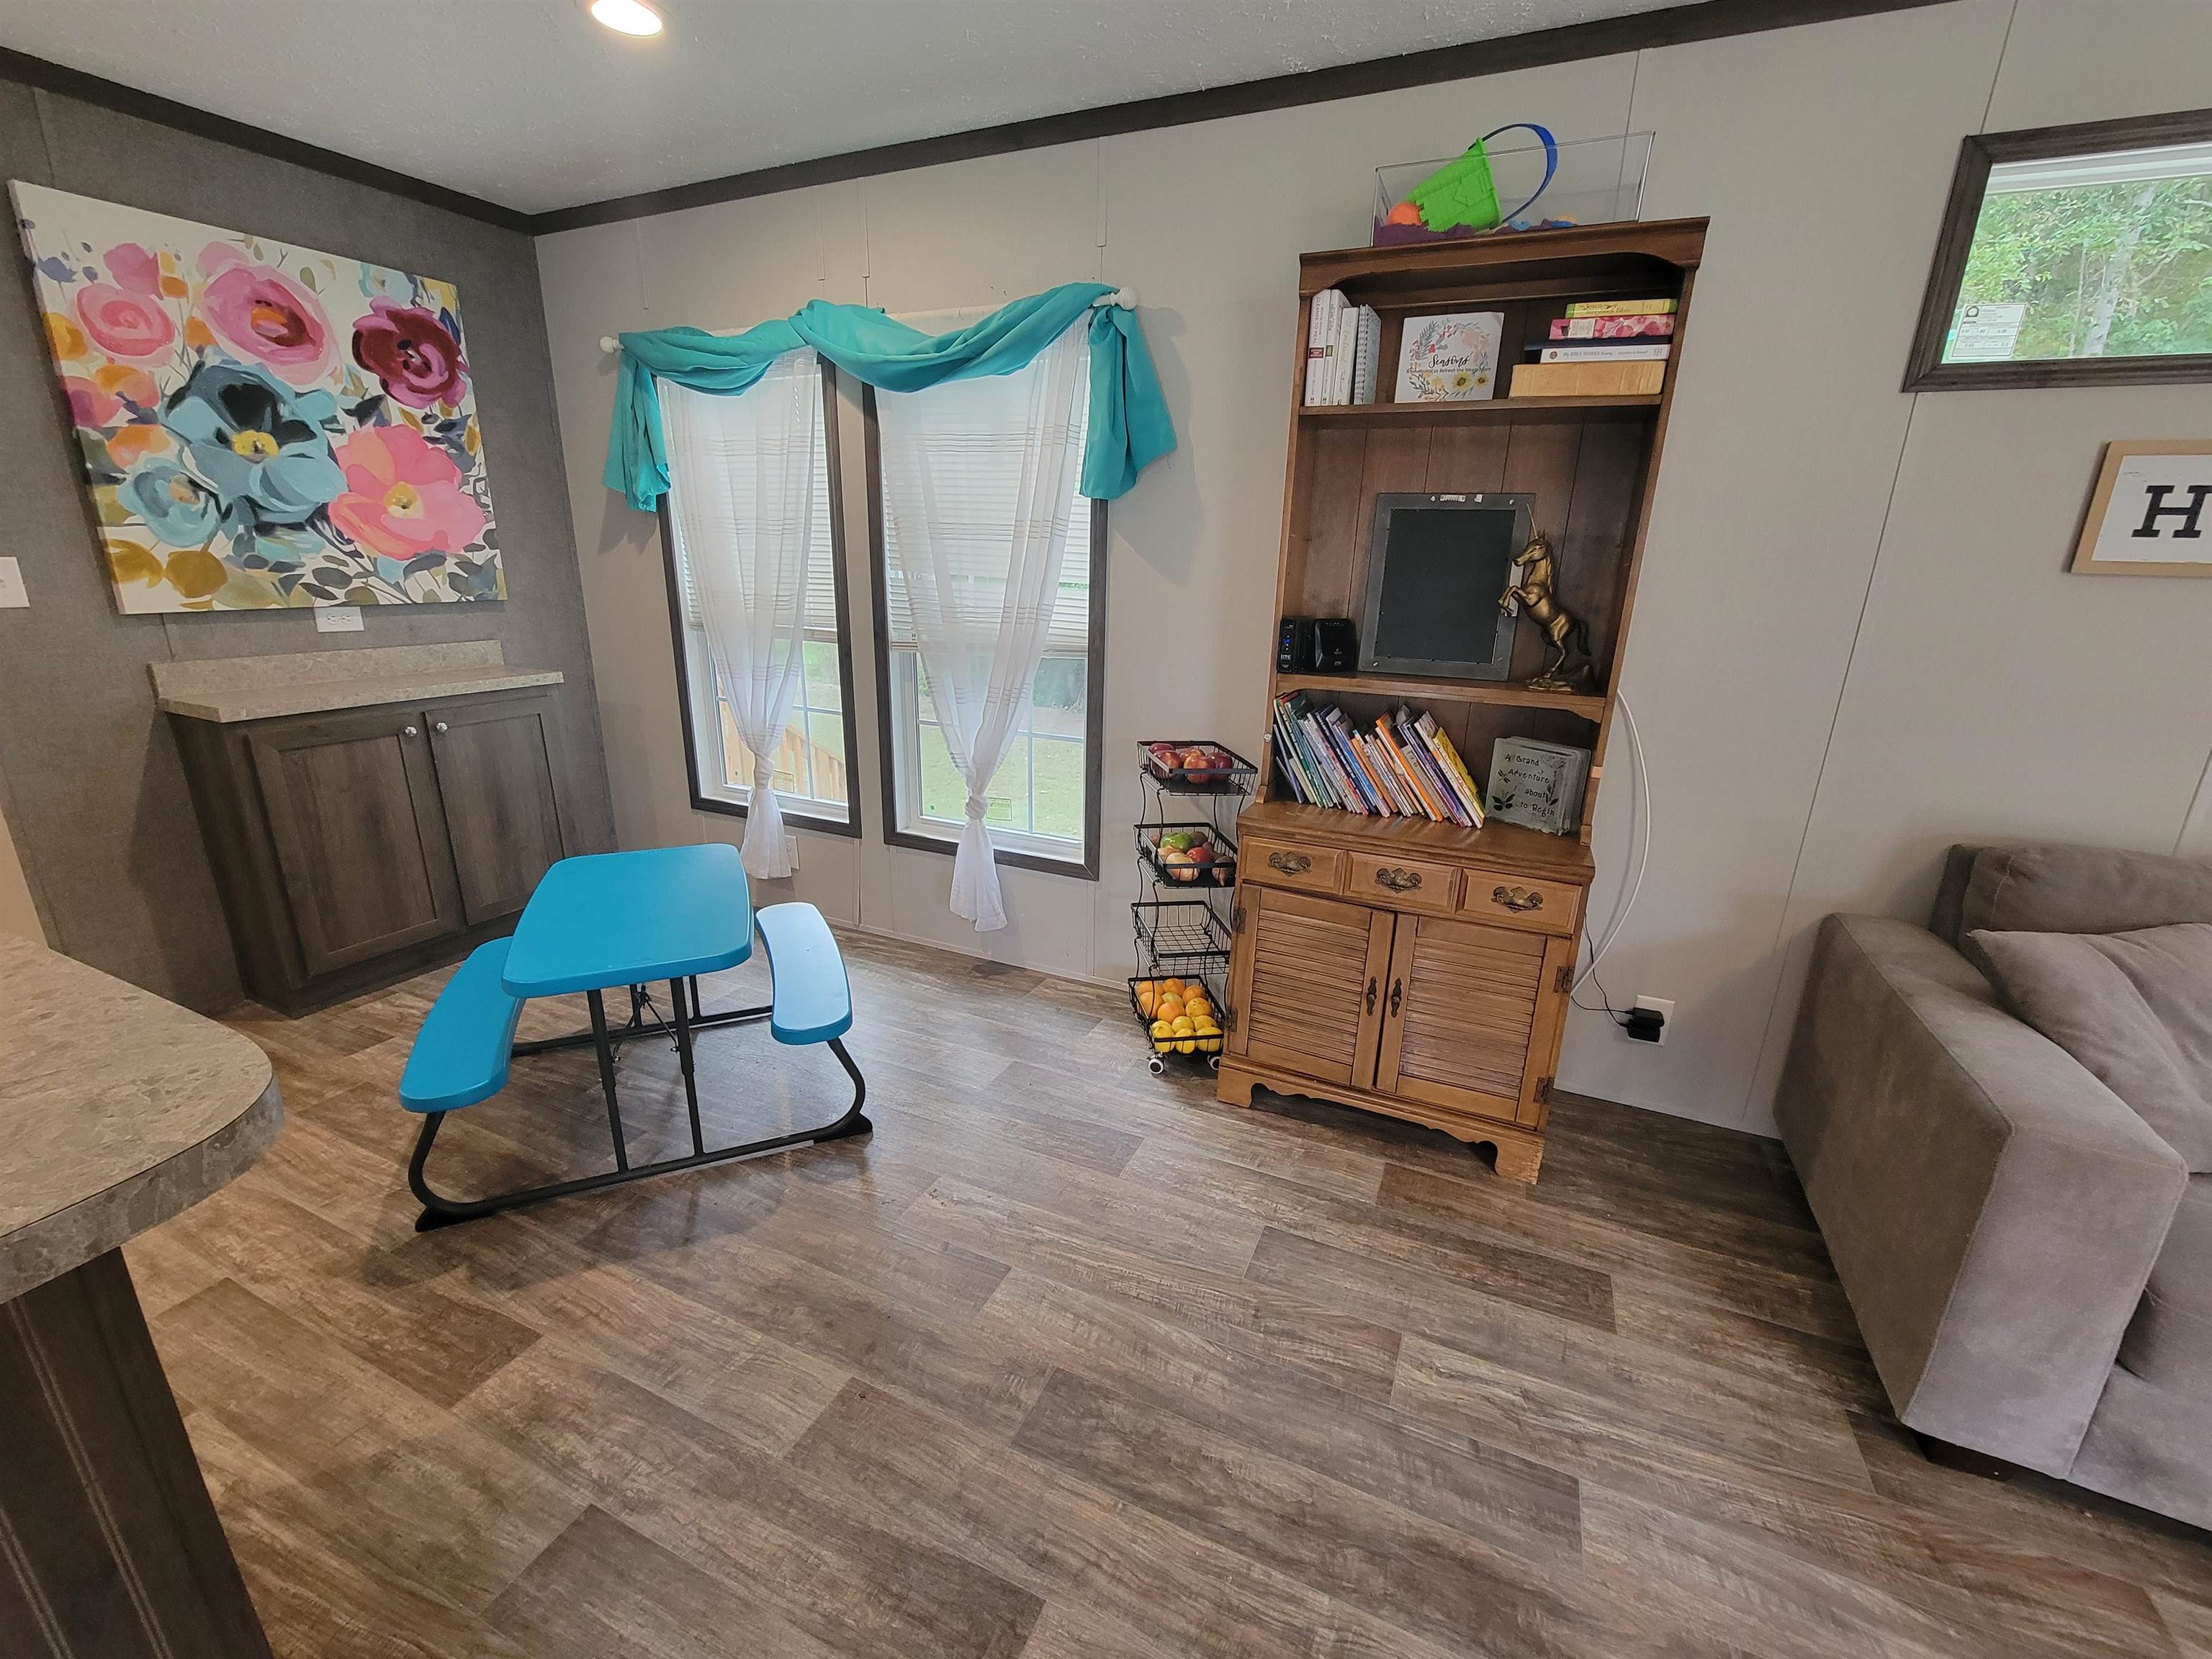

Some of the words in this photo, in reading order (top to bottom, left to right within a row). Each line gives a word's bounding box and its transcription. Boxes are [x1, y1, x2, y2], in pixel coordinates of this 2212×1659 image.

[1429, 353, 1472, 368] Seasons
[2131, 485, 2212, 539] H
[1516, 755, 1539, 766] Grand
[1508, 768, 1550, 783] Adventure
[1524, 788, 1546, 799] about
[1532, 804, 1555, 817] Begin
